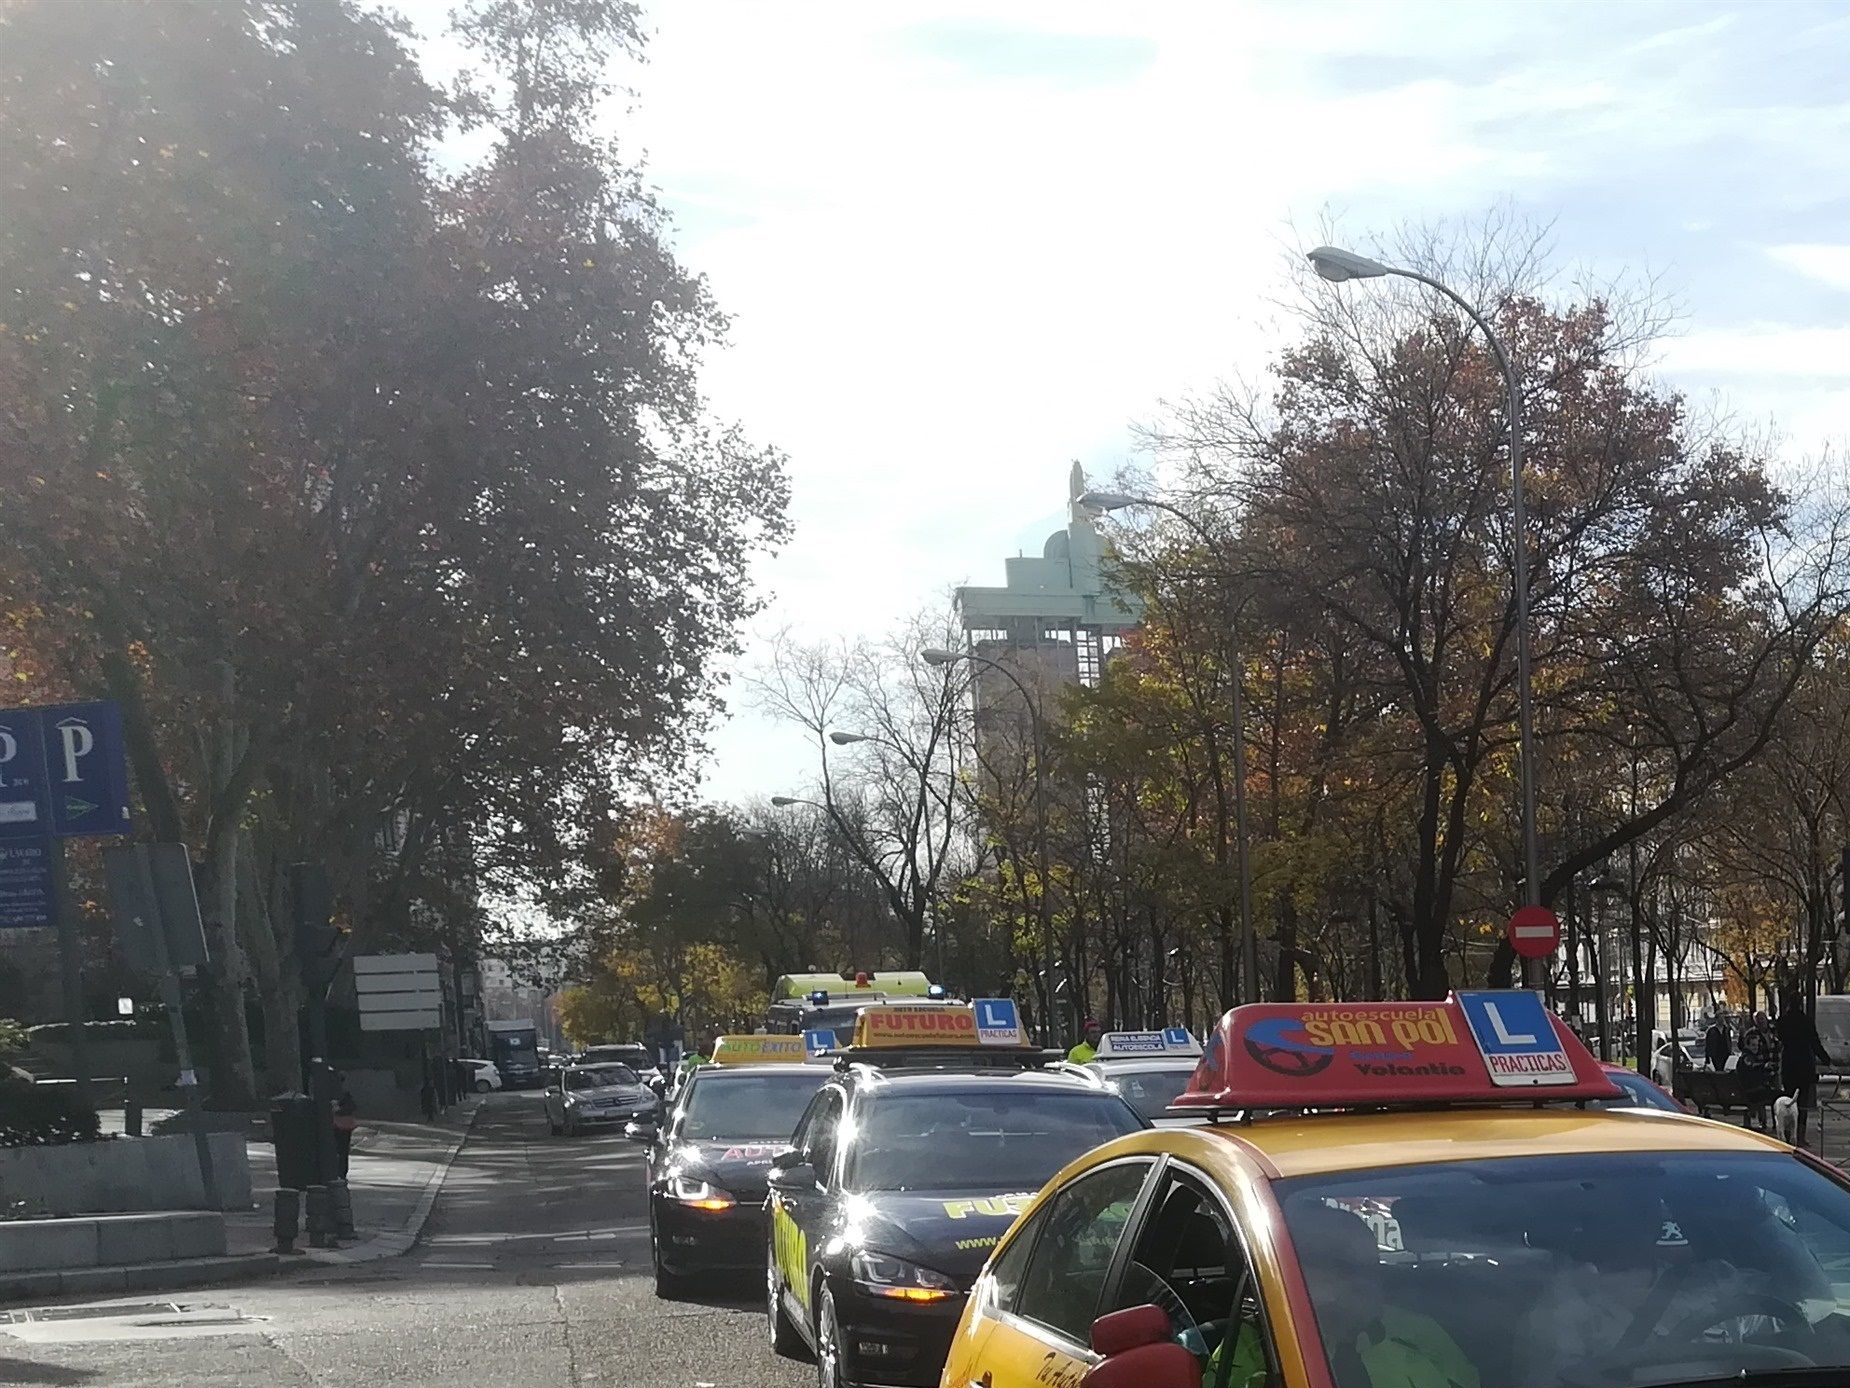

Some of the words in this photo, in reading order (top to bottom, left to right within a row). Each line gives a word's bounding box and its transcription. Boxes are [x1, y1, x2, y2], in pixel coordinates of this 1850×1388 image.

[57, 726, 94, 781] P
[870, 1013, 973, 1030] FUTURO
[985, 1004, 1006, 1025] L
[1301, 1007, 1436, 1022] autoescuela
[1483, 1002, 1537, 1045] L
[812, 1033, 828, 1049] L
[1170, 1030, 1184, 1042] L
[1353, 1062, 1466, 1076] Volantia
[1489, 1054, 1567, 1073] PRACTICAS
